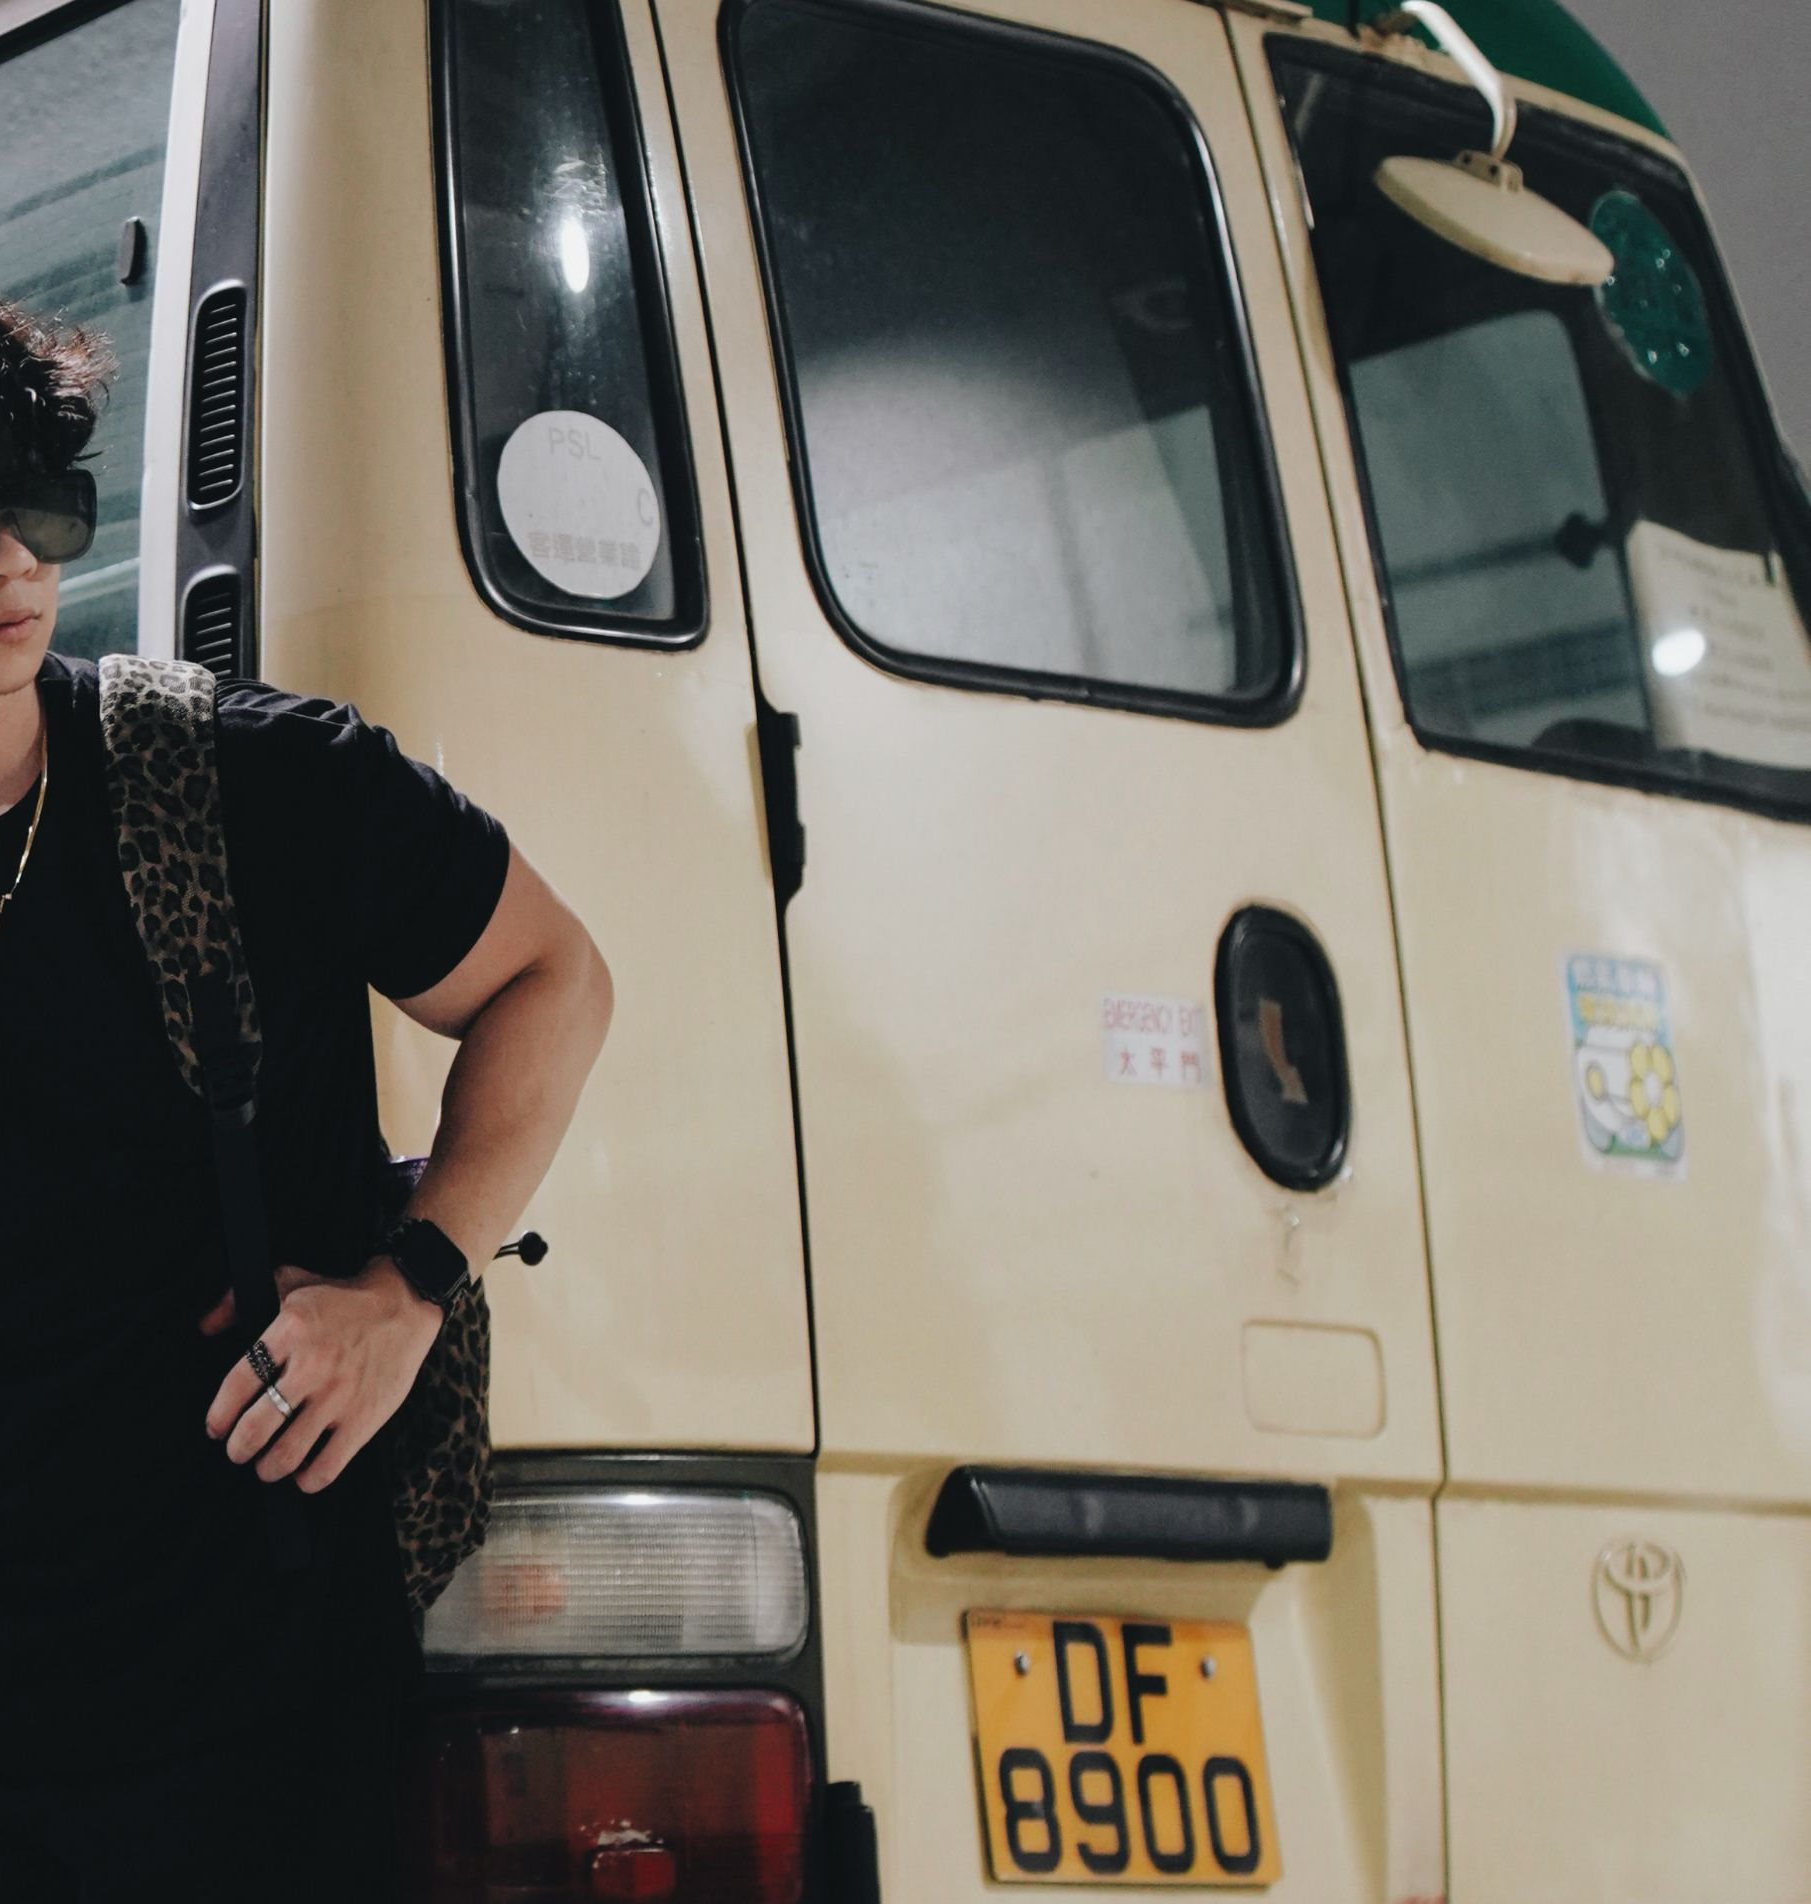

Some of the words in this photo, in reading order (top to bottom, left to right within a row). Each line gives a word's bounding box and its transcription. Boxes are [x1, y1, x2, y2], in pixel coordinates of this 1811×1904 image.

[548, 427, 602, 462] PSL
[1052, 1620, 1173, 1745] DF
[999, 1747, 1261, 1875] 8900
